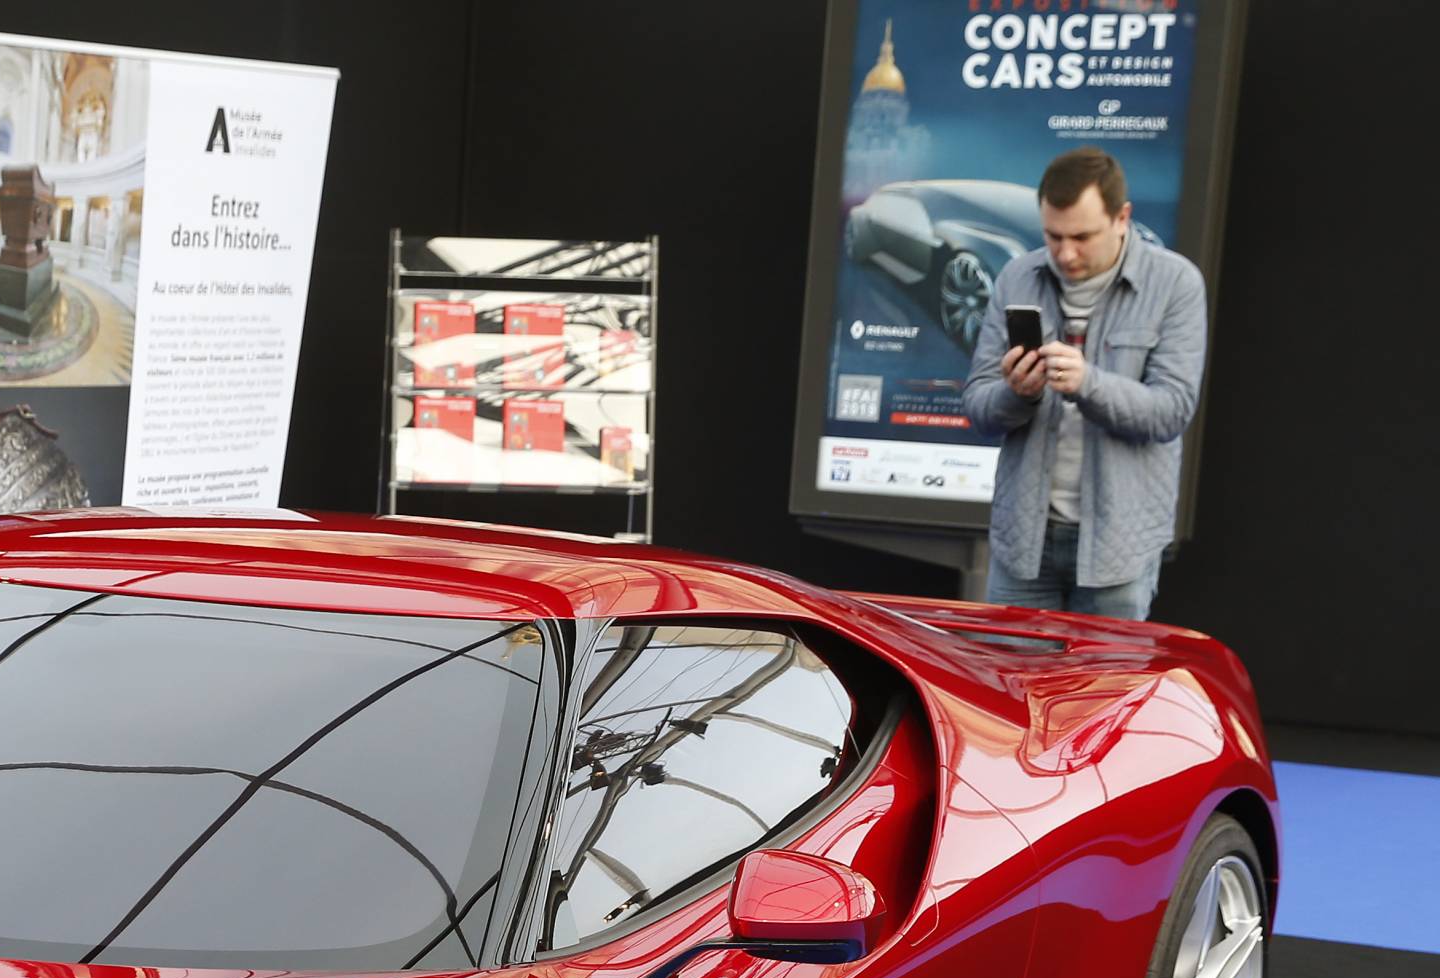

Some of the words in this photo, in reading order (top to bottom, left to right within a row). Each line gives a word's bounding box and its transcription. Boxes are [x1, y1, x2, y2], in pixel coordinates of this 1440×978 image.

[964, 13, 1177, 50] CONCEPT
[962, 52, 1085, 89] CARS
[1088, 56, 1109, 70] ET
[1111, 56, 1174, 71] DESIGN
[1086, 73, 1173, 87] AUTOMOBILE
[230, 108, 262, 122] Musée
[232, 126, 244, 138] de
[246, 127, 283, 141] l'Armée
[211, 194, 260, 218] Entrez
[171, 223, 209, 248] dans
[214, 224, 292, 251] l'histoire...
[152, 281, 165, 294] Au
[168, 283, 194, 295] coeur
[197, 281, 208, 294] de
[242, 282, 255, 296] des
[865, 324, 920, 339] RENAULT
